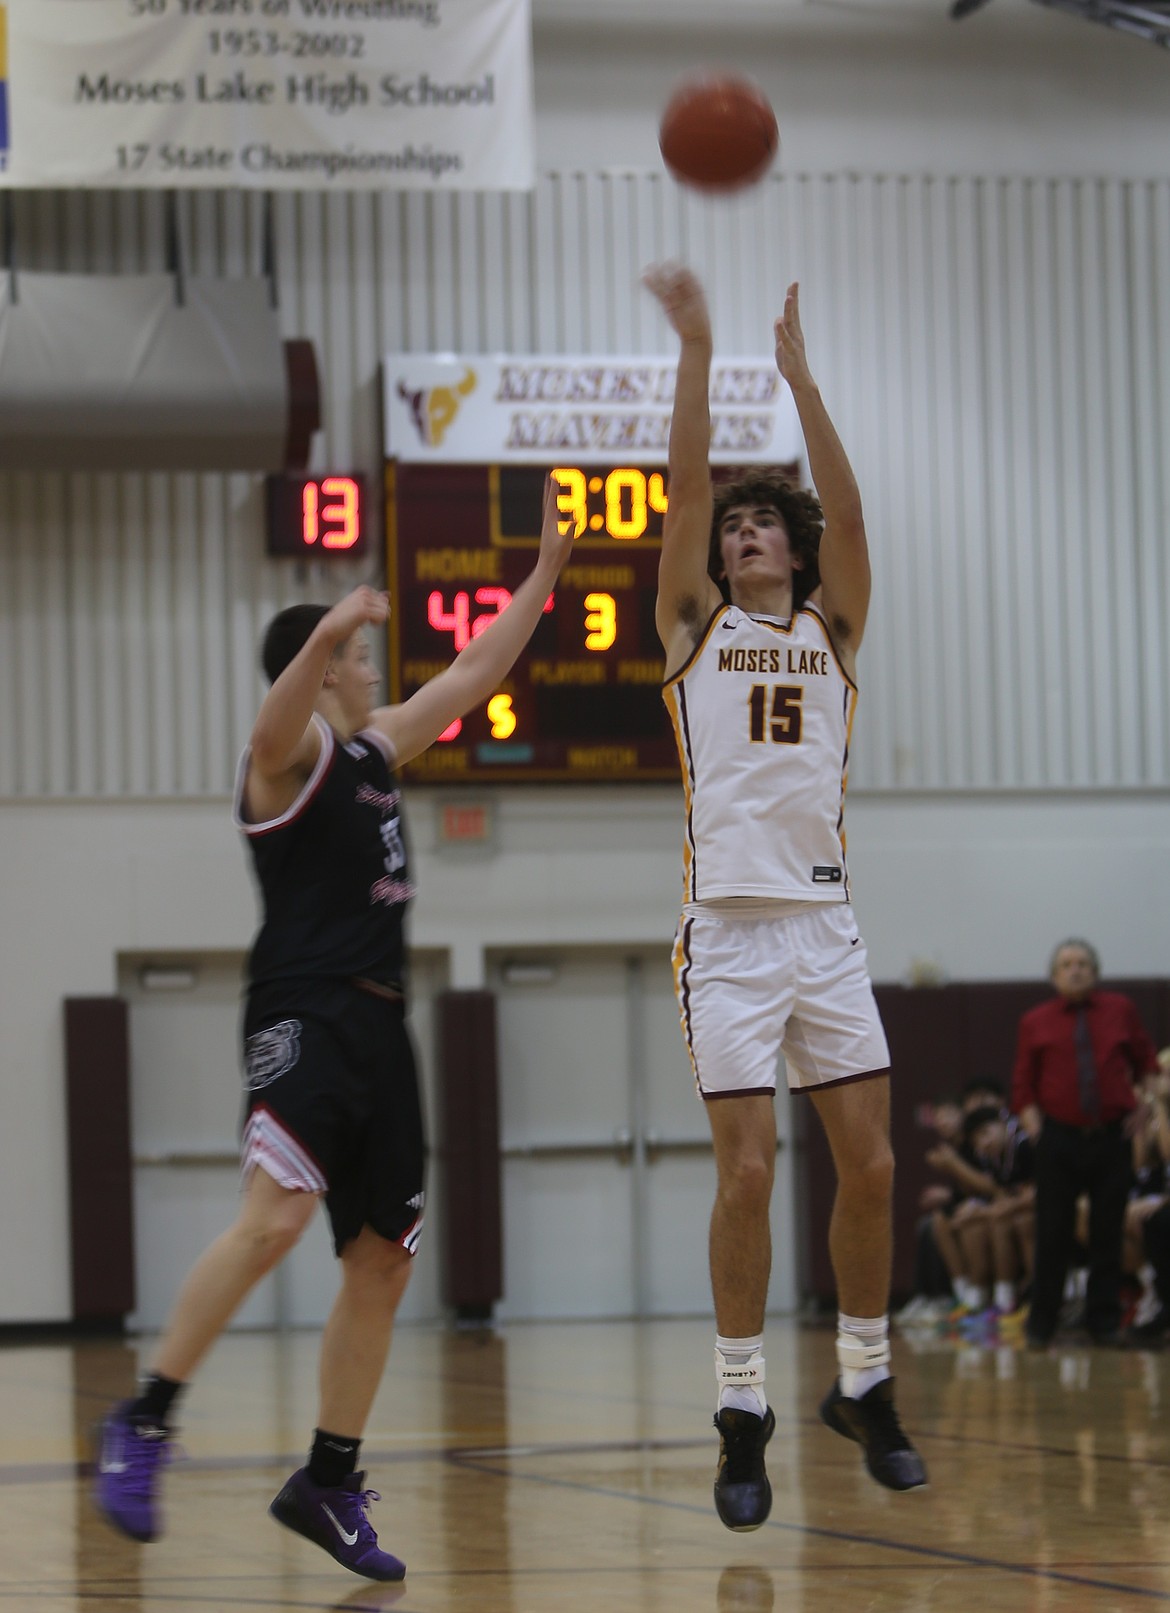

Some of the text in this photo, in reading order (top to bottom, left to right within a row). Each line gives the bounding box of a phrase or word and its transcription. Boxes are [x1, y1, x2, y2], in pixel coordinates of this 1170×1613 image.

[208, 29, 366, 58] 1953-2002
[76, 70, 495, 115] Moses Lake High School
[116, 142, 463, 179] 17 State Championships
[496, 366, 779, 401] MOSES LKE
[302, 477, 360, 549] 13
[416, 551, 500, 581] HOME
[584, 592, 617, 651] 3
[717, 648, 829, 676] MOSES LAKE
[486, 693, 517, 739] 5
[746, 683, 805, 746] 15
